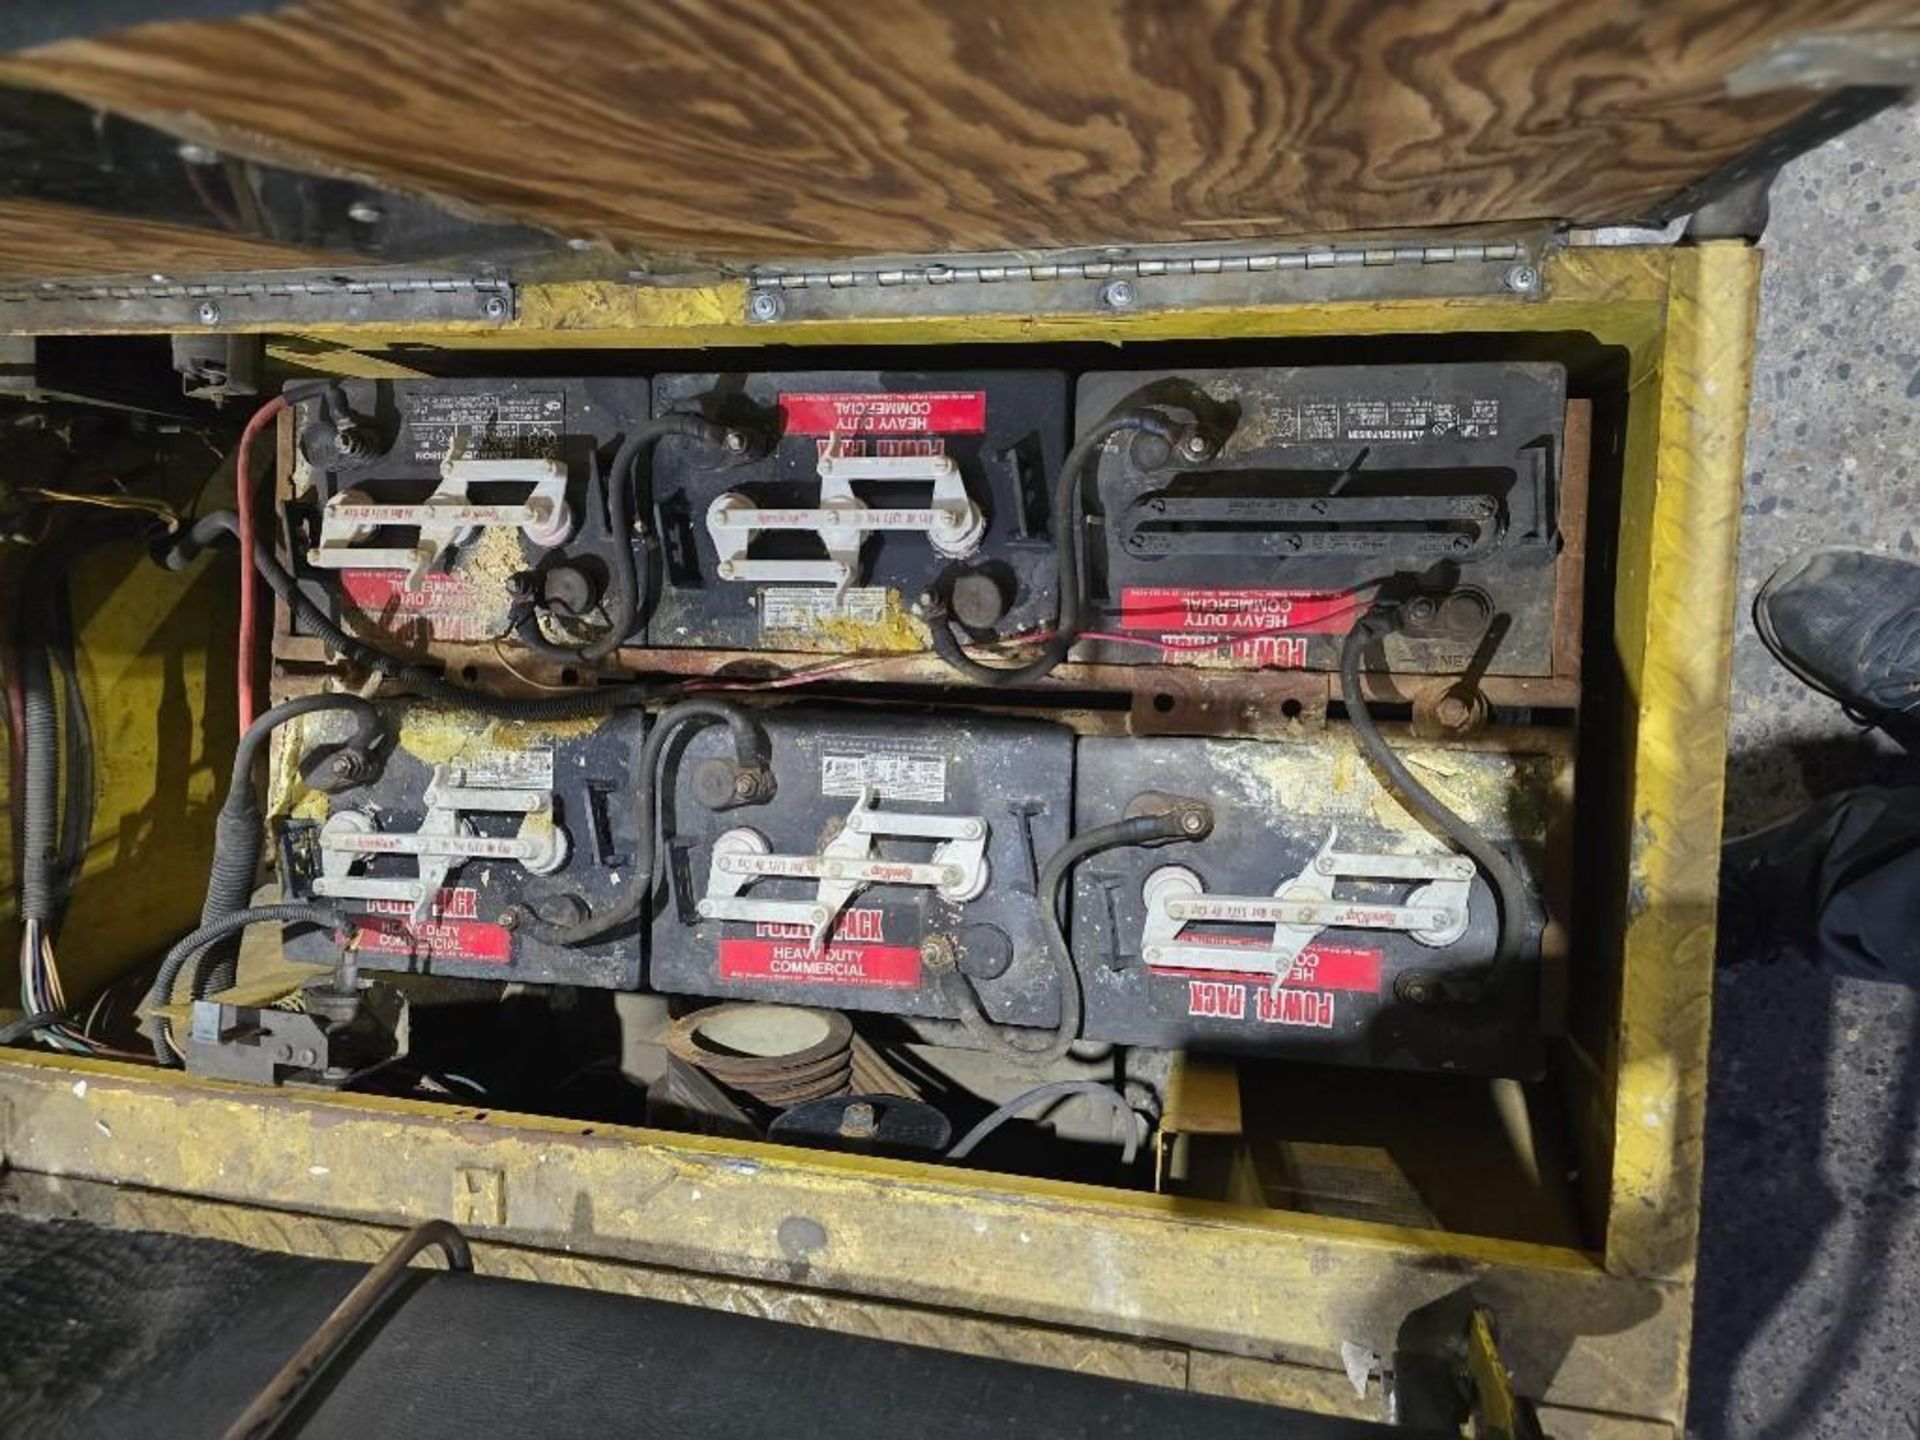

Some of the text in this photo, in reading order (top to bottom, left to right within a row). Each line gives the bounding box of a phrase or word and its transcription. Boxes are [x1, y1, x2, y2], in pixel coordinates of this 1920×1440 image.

[833, 402, 932, 415] COMMERCIAL
[836, 416, 928, 430] HEAVY DUTY
[1180, 598, 1293, 613] COMMERCIAL
[1183, 612, 1289, 629] HEAVY DUTY
[427, 924, 460, 937] DUTY
[833, 908, 884, 942] PACK
[773, 947, 865, 963] HEAVY DUTY
[770, 961, 867, 978] COMMERCIAL
[1189, 981, 1334, 1029] POWER PACK
